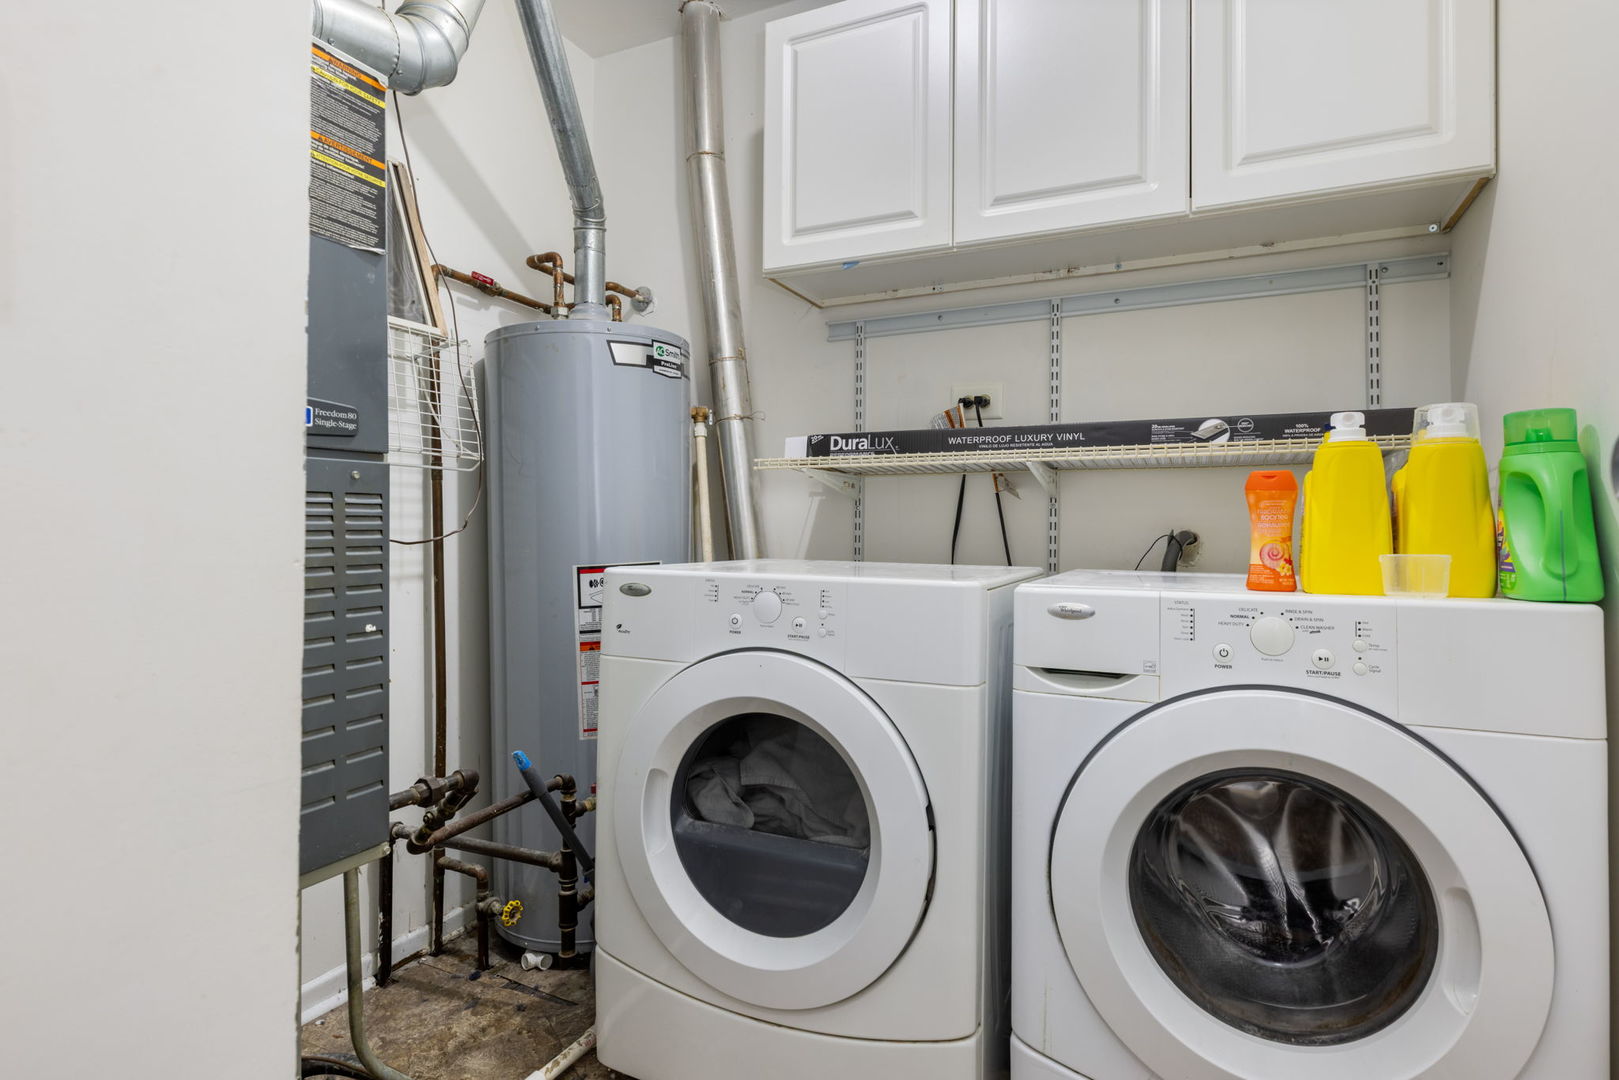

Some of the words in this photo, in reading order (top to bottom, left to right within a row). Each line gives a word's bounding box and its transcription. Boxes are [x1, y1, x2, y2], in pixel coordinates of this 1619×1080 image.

[665, 348, 680, 360] Smith
[315, 407, 347, 419] Freedom
[347, 412, 357, 421] 80
[314, 417, 357, 431] Single-Stage
[830, 434, 895, 453] DuraLux
[948, 434, 1012, 446] WATERPROOF
[1014, 433, 1054, 444] LUXURY
[1056, 431, 1086, 442] VINYL
